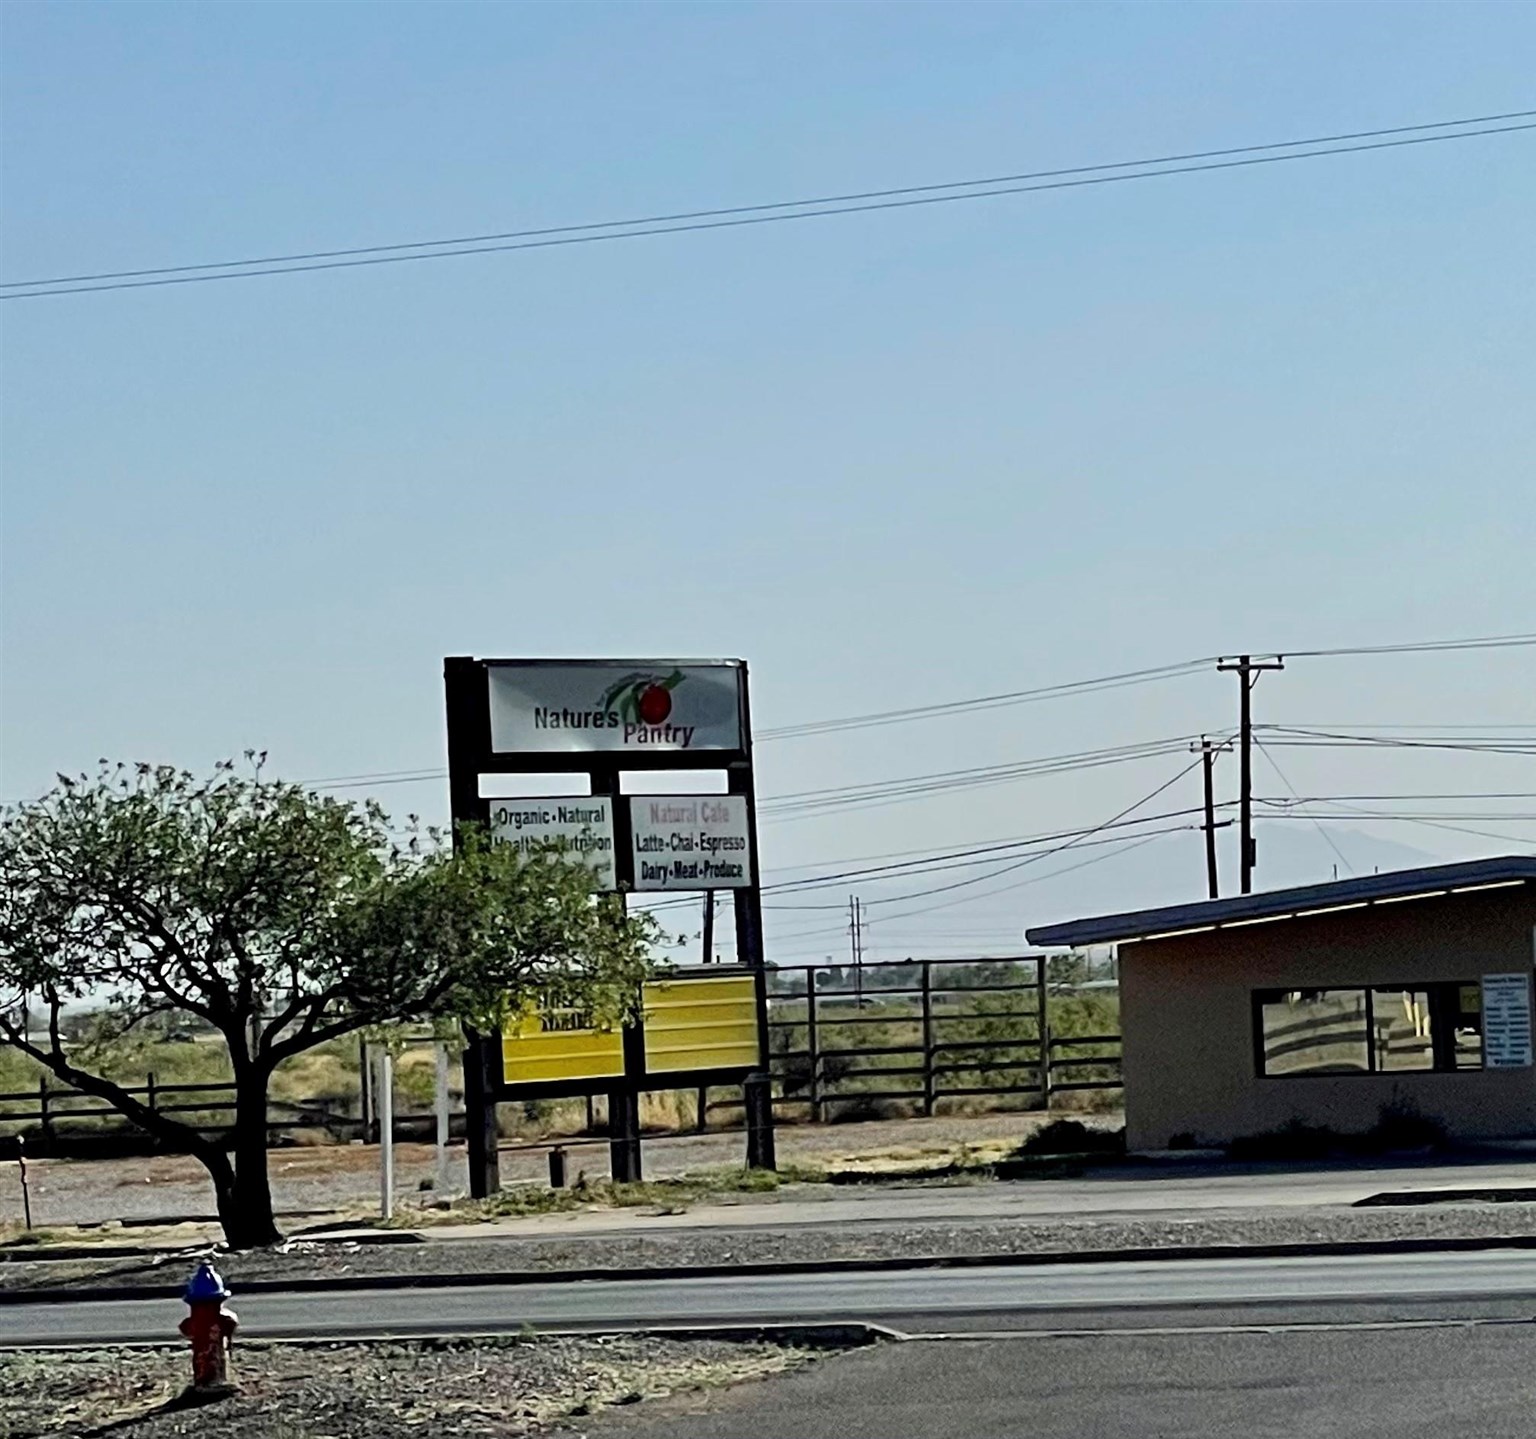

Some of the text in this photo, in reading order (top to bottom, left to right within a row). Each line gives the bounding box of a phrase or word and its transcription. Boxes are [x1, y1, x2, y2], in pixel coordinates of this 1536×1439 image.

[624, 722, 695, 748] Pantry
[650, 801, 730, 824] Natural Cafe
